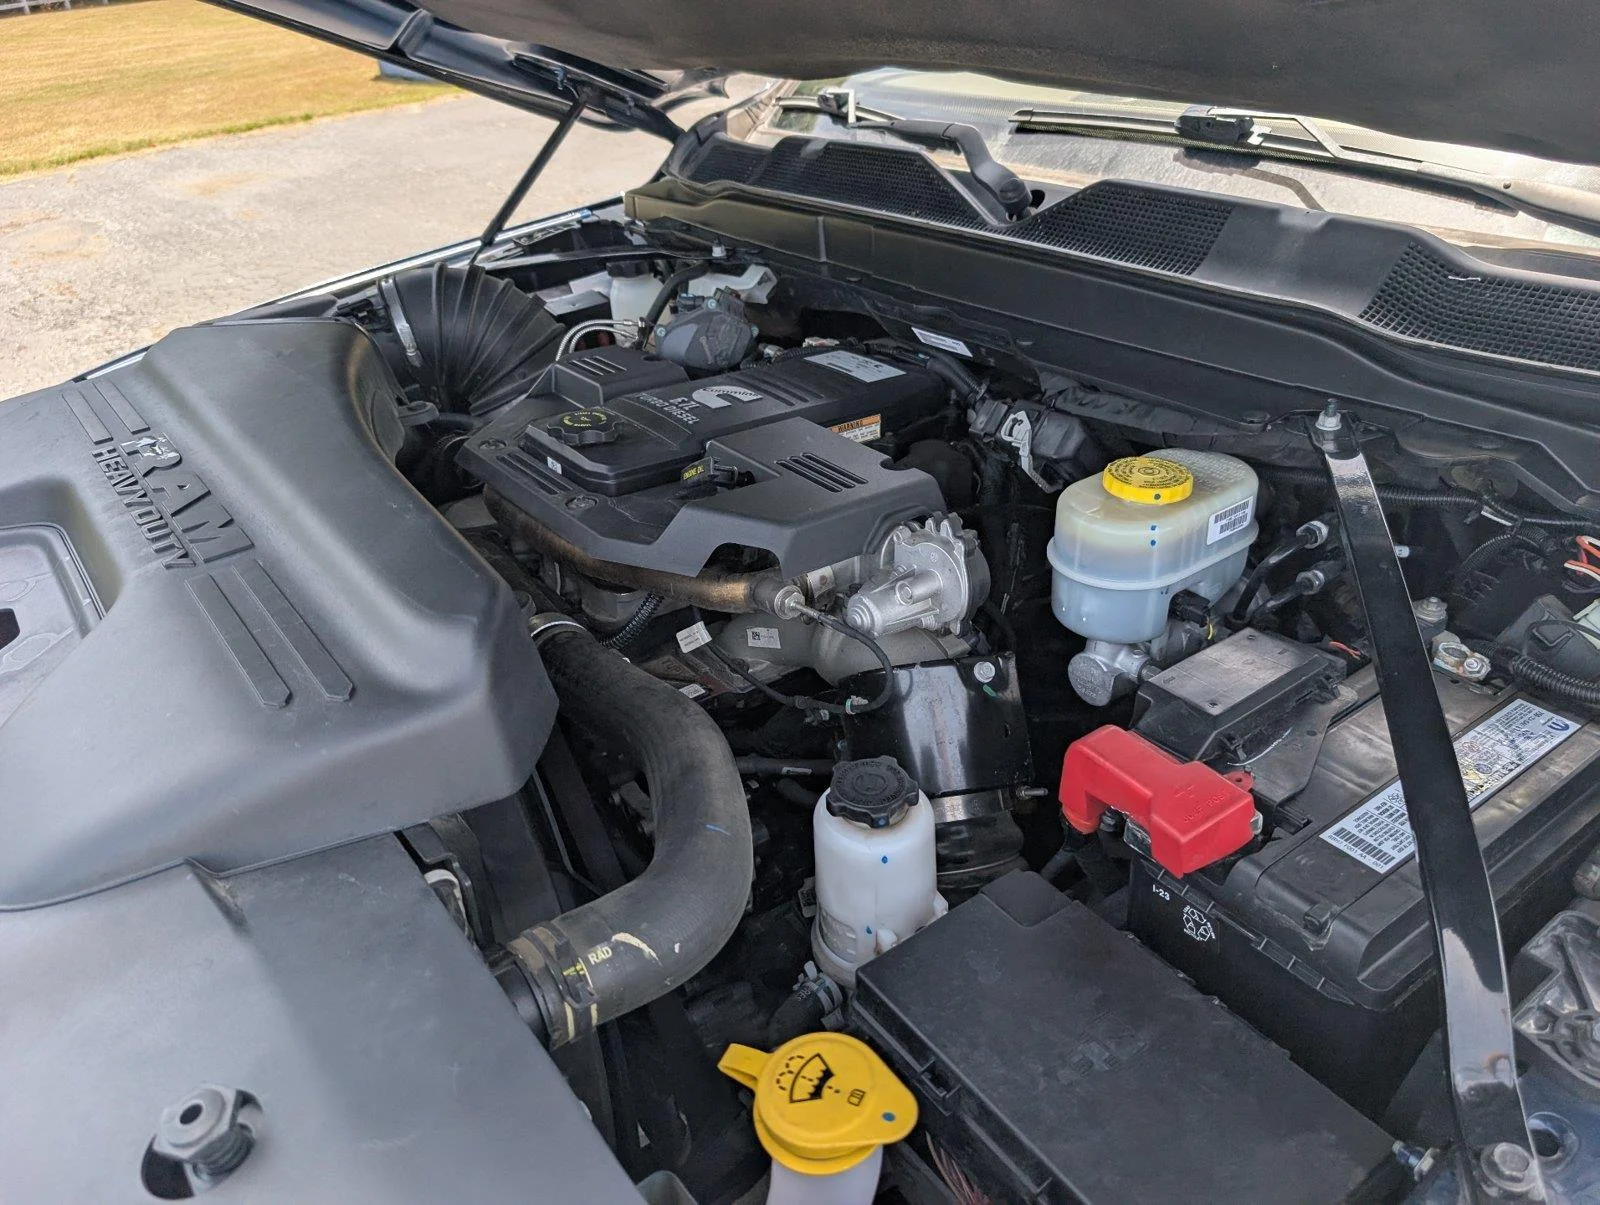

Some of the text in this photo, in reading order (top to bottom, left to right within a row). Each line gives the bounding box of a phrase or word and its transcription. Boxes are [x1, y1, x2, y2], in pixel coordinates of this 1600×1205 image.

[663, 405, 700, 424] DIESEL
[838, 419, 863, 433] WARNING
[119, 432, 255, 563] RAM
[92, 446, 197, 569] HEAVY DUTY
[588, 946, 613, 965] RAD
